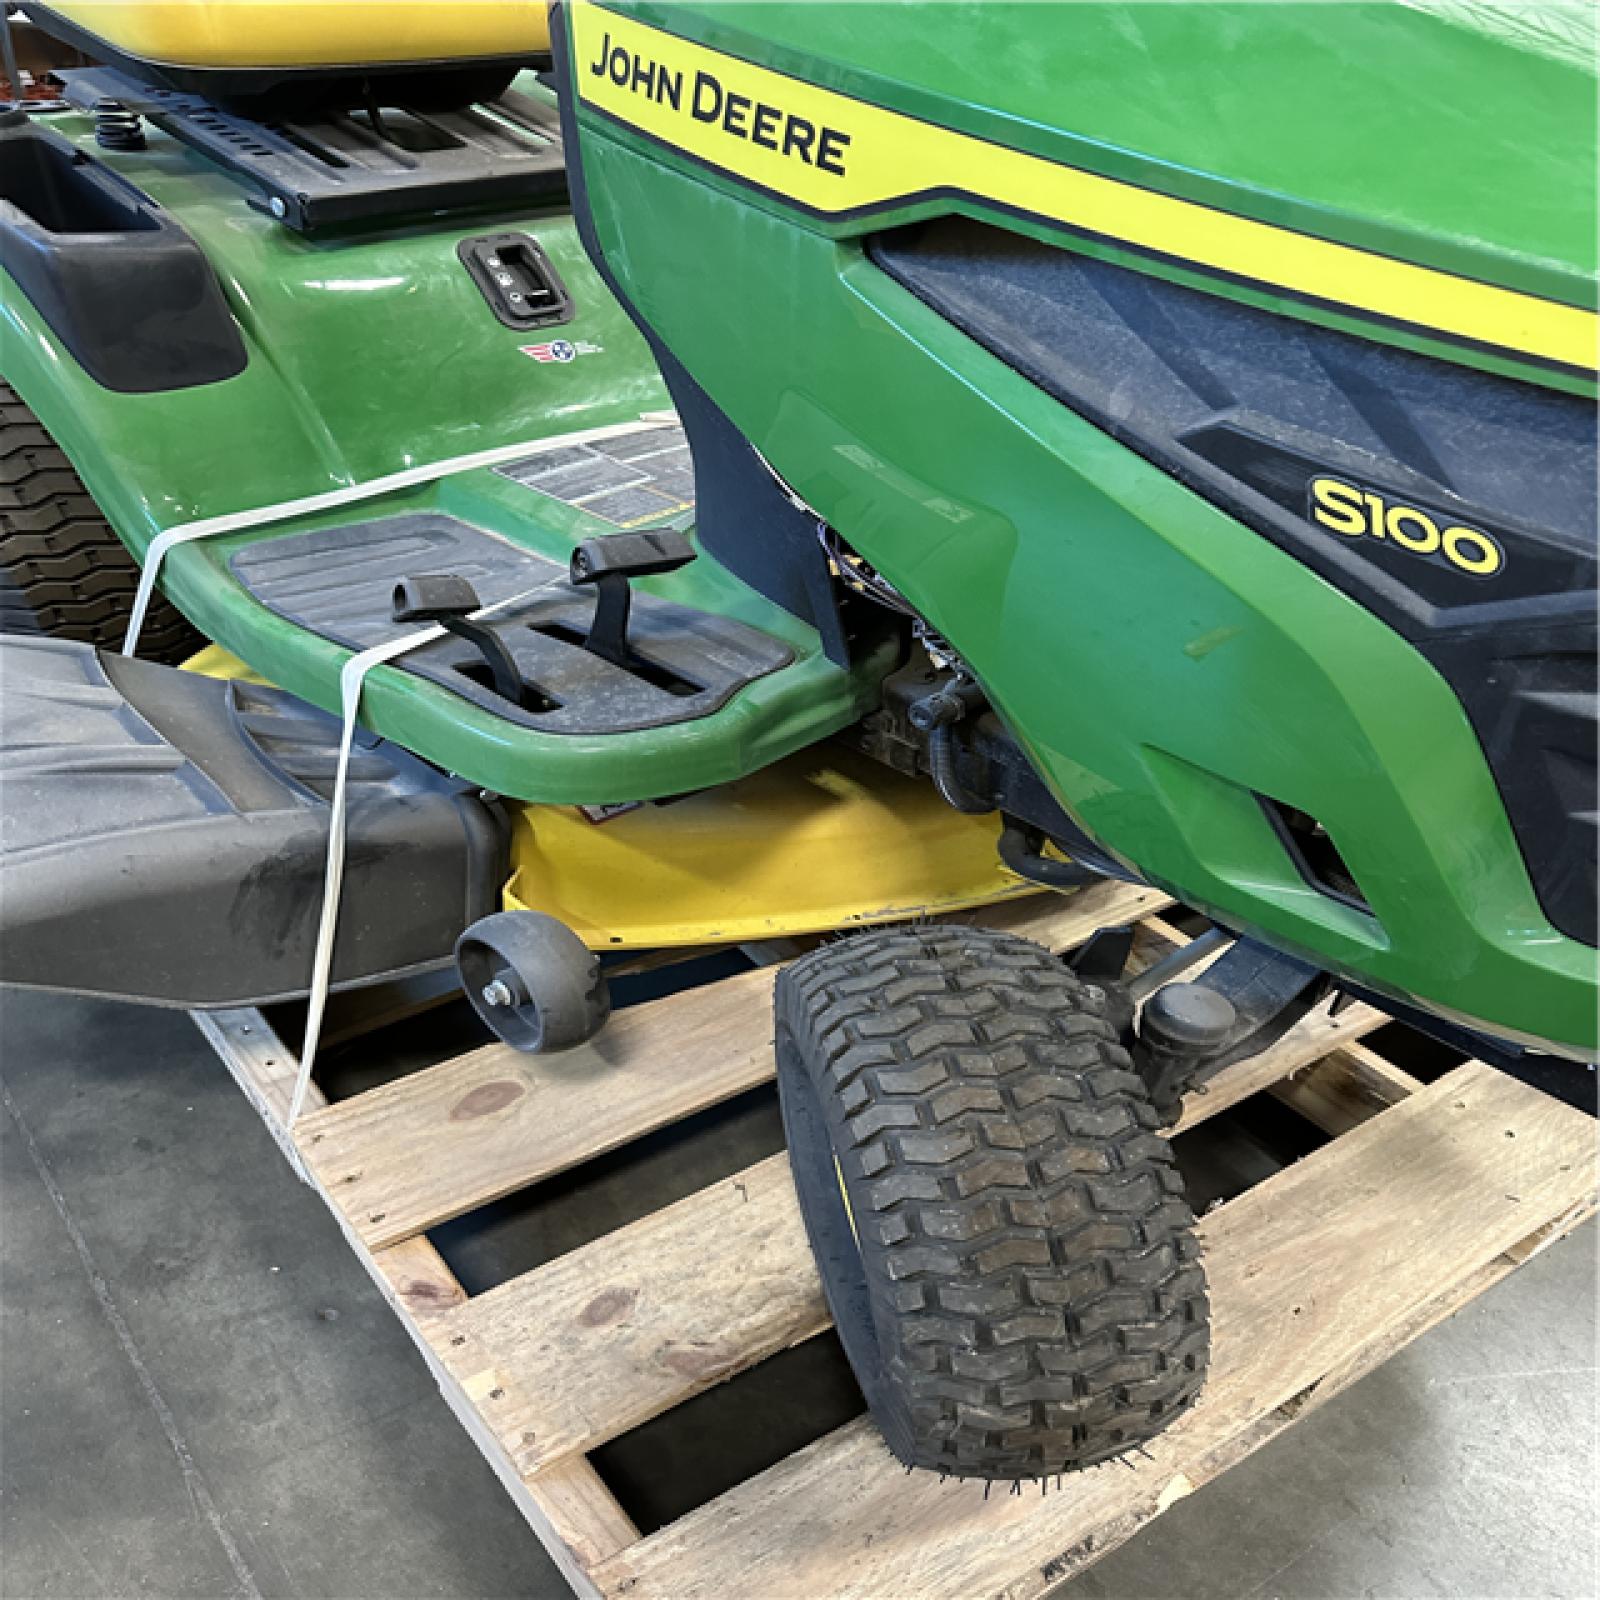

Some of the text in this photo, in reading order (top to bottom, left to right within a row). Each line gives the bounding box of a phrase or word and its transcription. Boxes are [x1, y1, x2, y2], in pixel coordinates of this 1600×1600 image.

[591, 32, 851, 177] JOHN DEERE
[1312, 479, 1500, 574] S100
